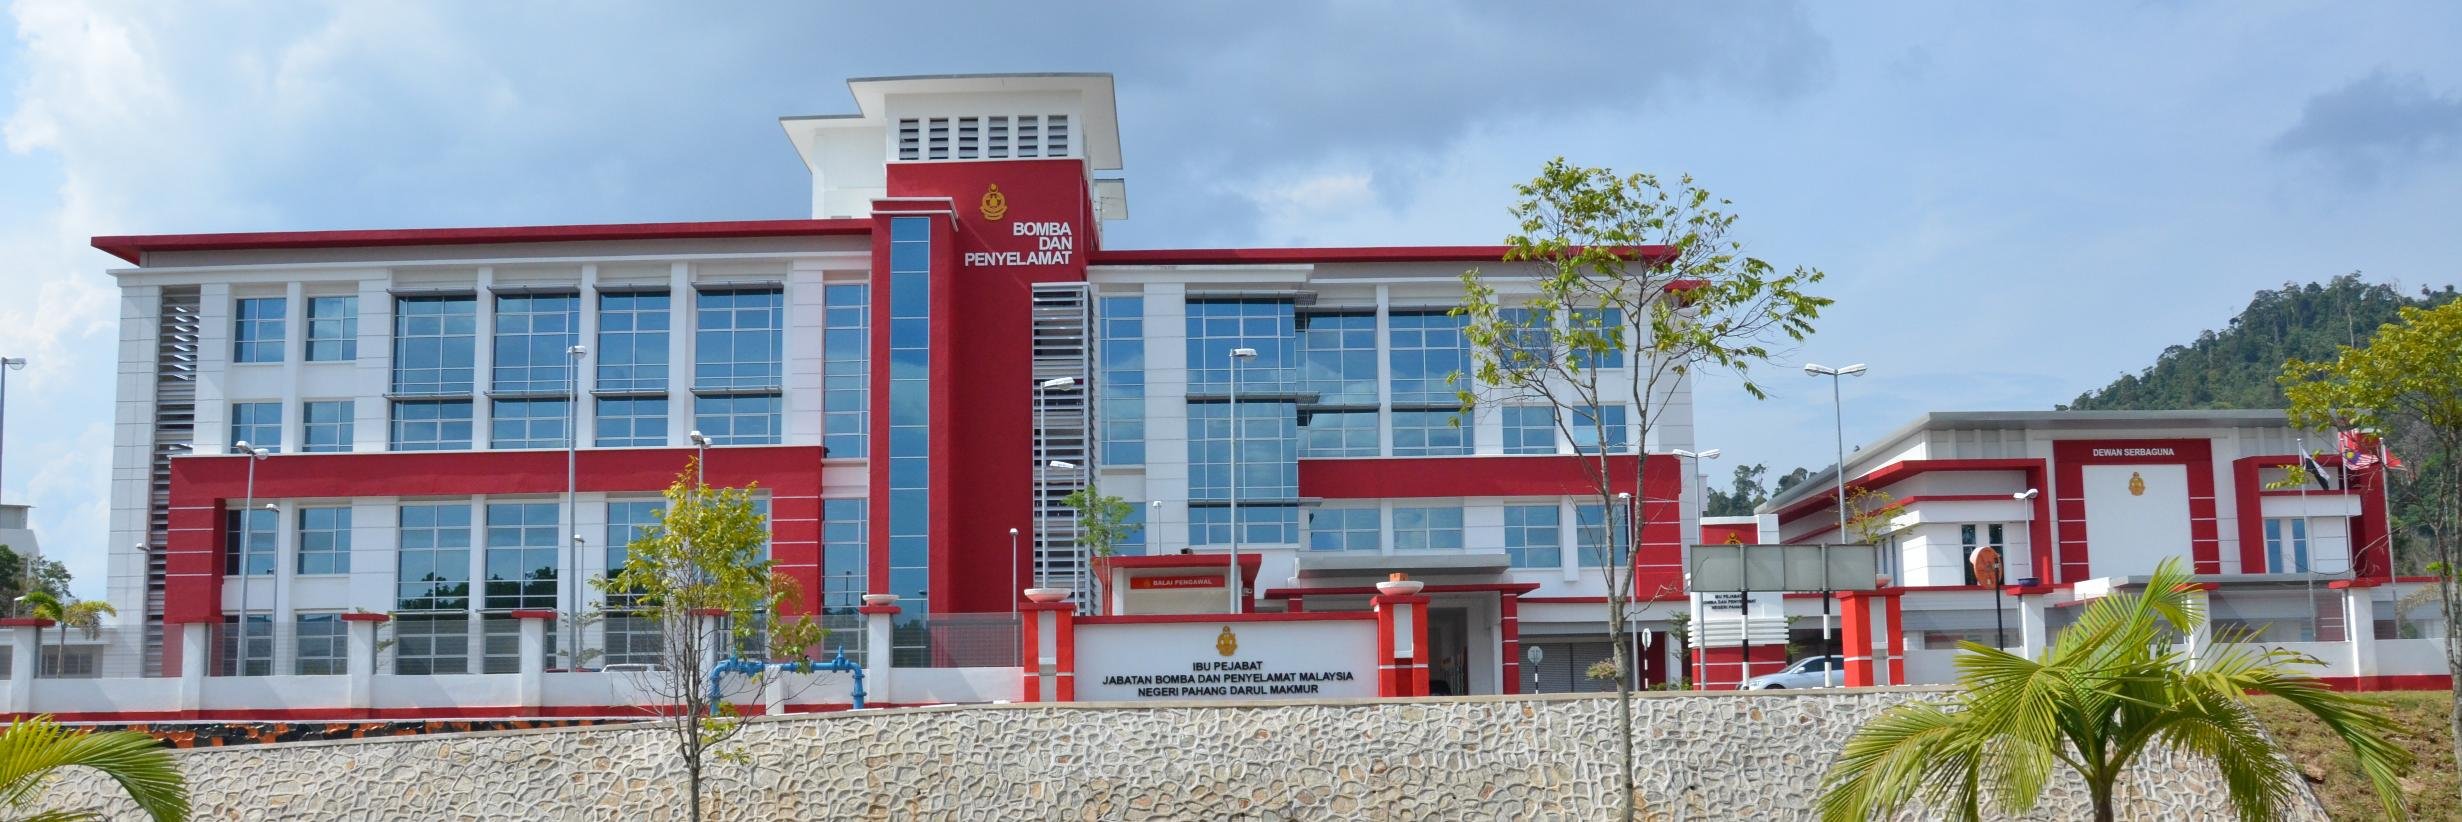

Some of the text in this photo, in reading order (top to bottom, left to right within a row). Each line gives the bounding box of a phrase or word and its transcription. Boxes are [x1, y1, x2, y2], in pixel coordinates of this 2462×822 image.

[1013, 222, 1072, 236] BOMBA
[1039, 236, 1072, 250] DAN
[965, 251, 1072, 266] PENYELAMAT
[2093, 448, 2175, 457] DEWAN SERBAGUNA
[1193, 661, 1263, 671] IBU PEJABAT
[1102, 672, 1354, 685] JABATAN BOMBA DAN PENYELAMAT MALAYSIA
[1138, 684, 1319, 697] NEGERI PAHANG DARUL MAKMUR
